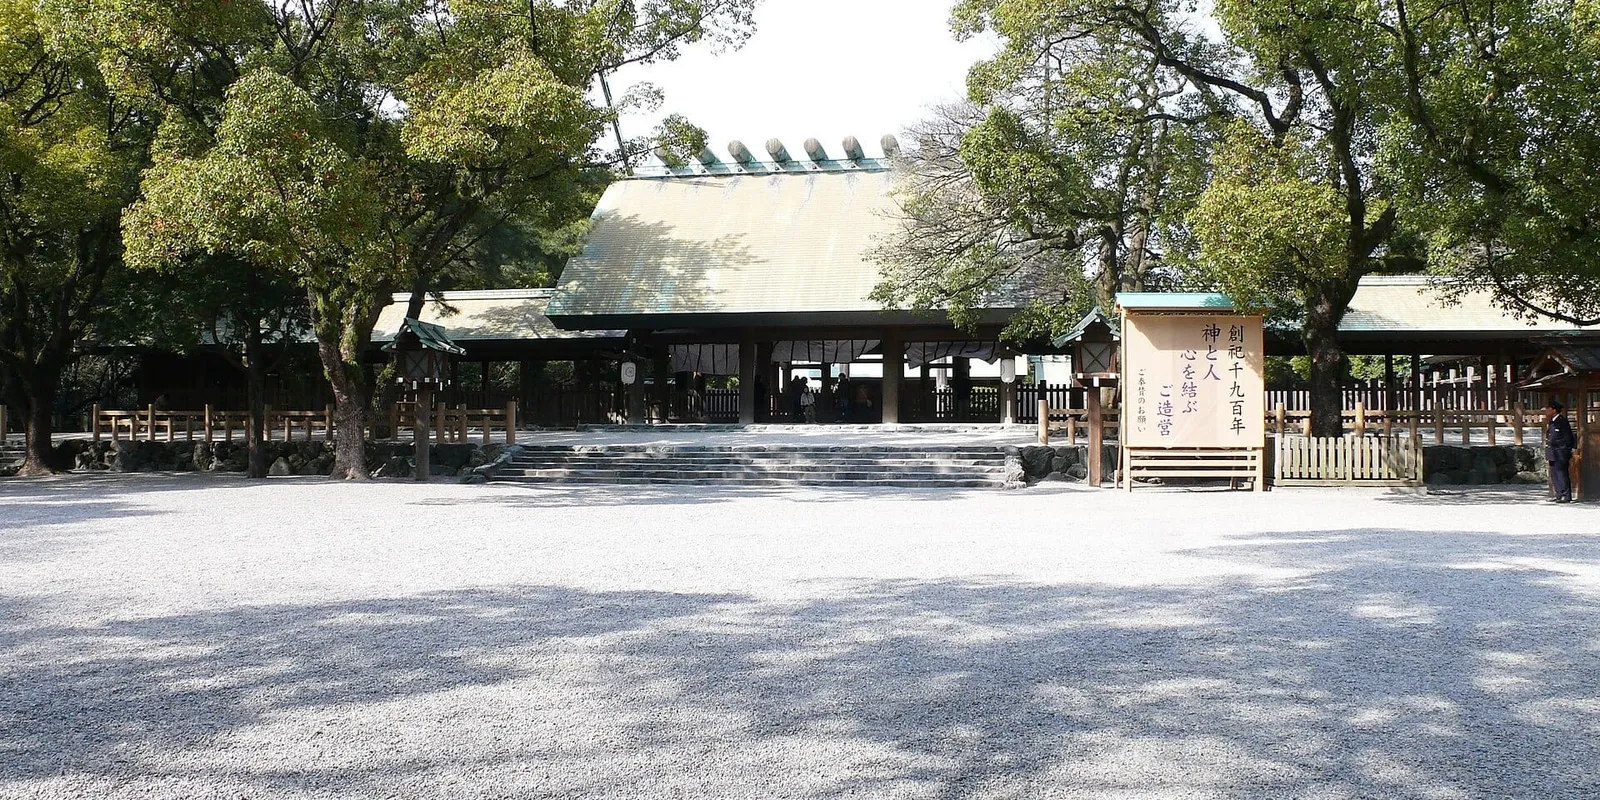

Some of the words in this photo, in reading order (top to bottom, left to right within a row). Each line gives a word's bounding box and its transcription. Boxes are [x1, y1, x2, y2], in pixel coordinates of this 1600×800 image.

[1180, 349, 1198, 414] 心を結ぶ
[1202, 323, 1221, 381] 神と人
[1228, 324, 1246, 436] 創祀千九百年
[1157, 384, 1174, 436] ご造営
